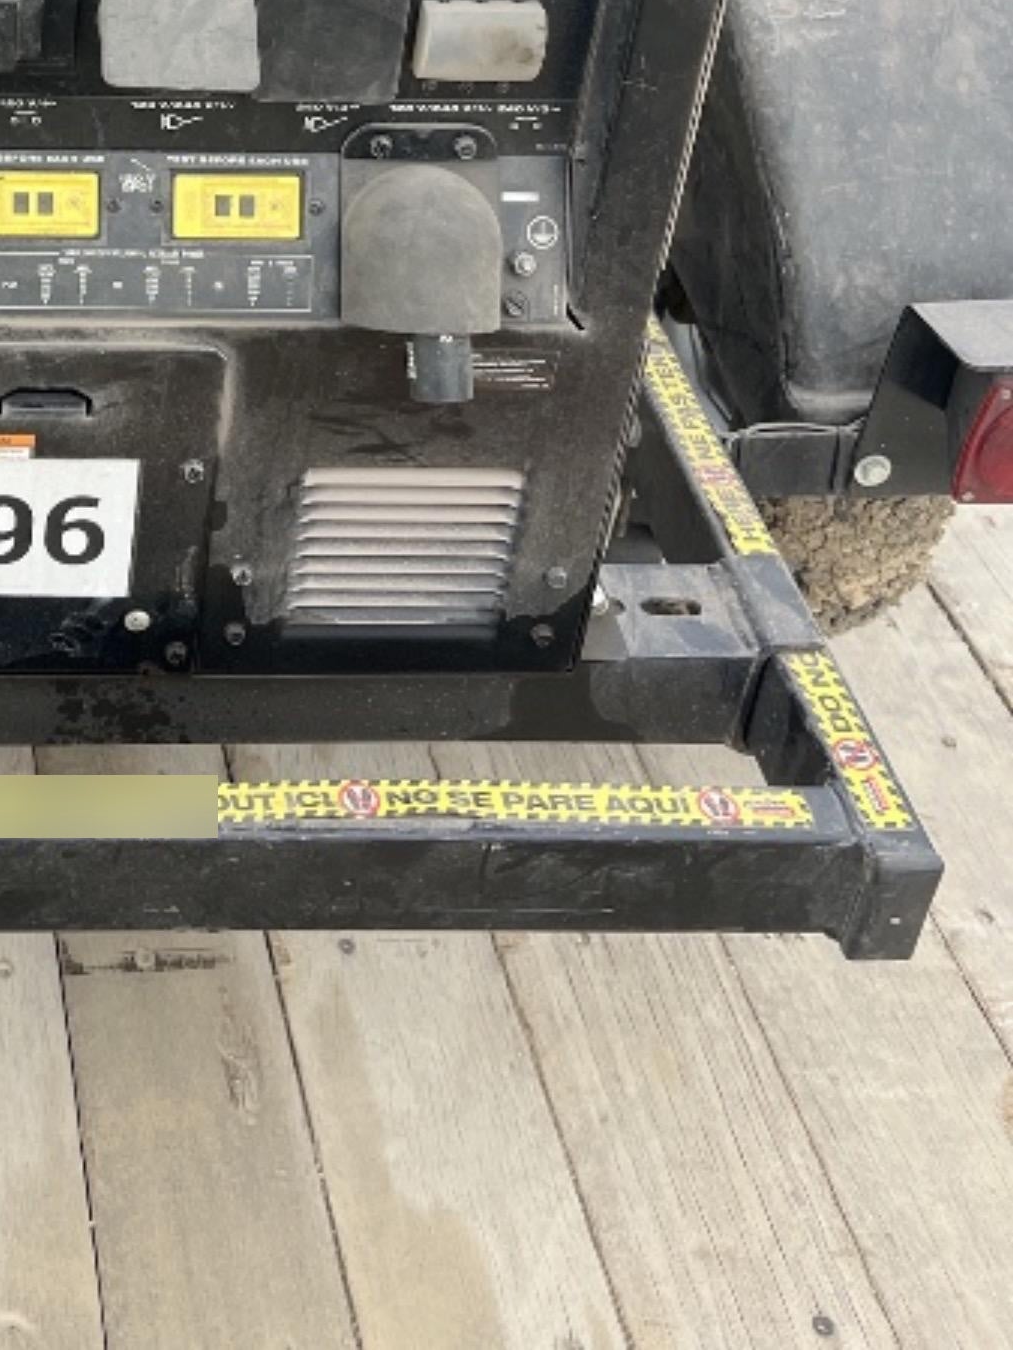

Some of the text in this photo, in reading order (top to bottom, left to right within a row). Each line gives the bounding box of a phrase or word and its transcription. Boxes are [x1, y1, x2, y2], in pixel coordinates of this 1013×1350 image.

[817, 696, 852, 732] DO
[387, 787, 691, 814] NO SE PARE AQUI
